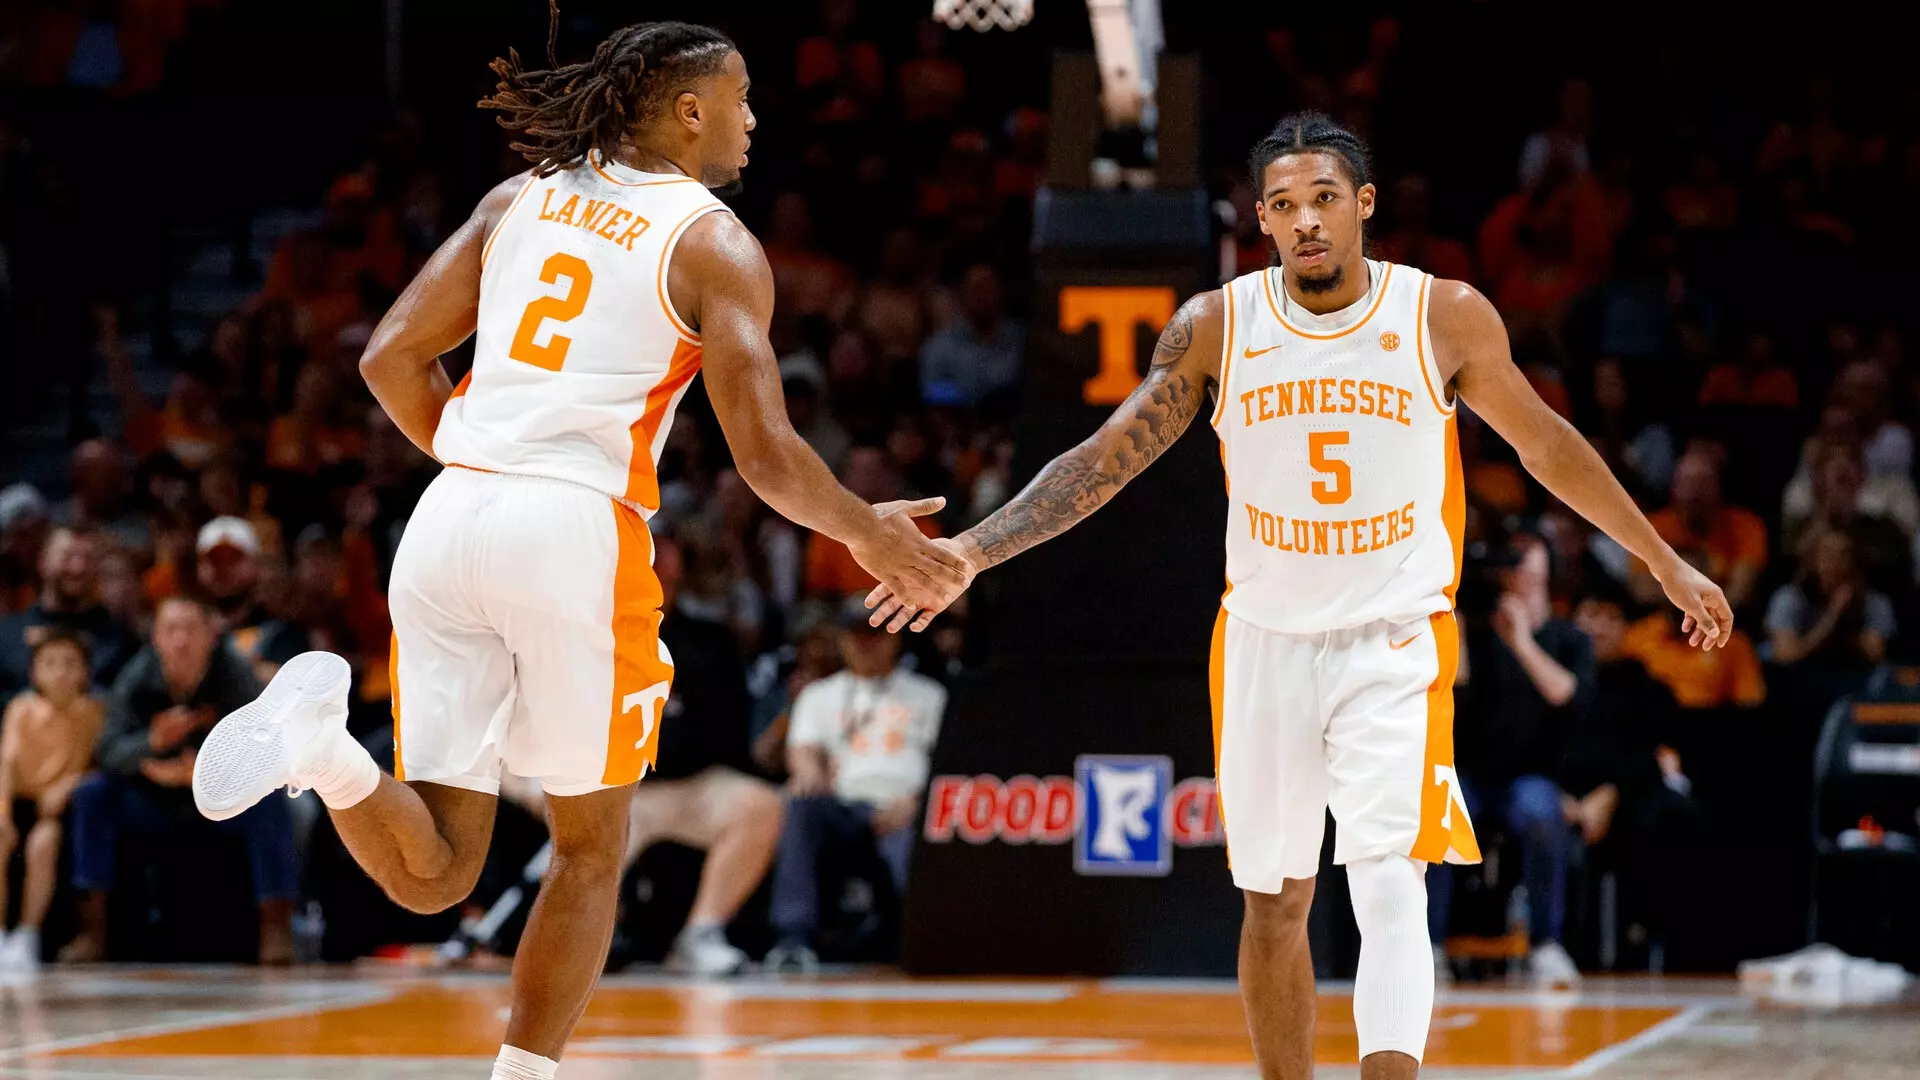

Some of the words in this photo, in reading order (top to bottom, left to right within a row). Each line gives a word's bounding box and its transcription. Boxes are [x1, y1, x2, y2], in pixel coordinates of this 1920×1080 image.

[538, 188, 651, 251] LANIER
[509, 252, 594, 372] 2
[1060, 287, 1175, 404] T
[1382, 333, 1399, 350] SEC
[1240, 378, 1413, 427] TENNESSEE
[1308, 431, 1352, 505] 5
[1245, 500, 1415, 555] VOLUNTEERS
[622, 680, 669, 749] T
[925, 774, 1083, 844] FOOD
[1164, 777, 1226, 846] CI
